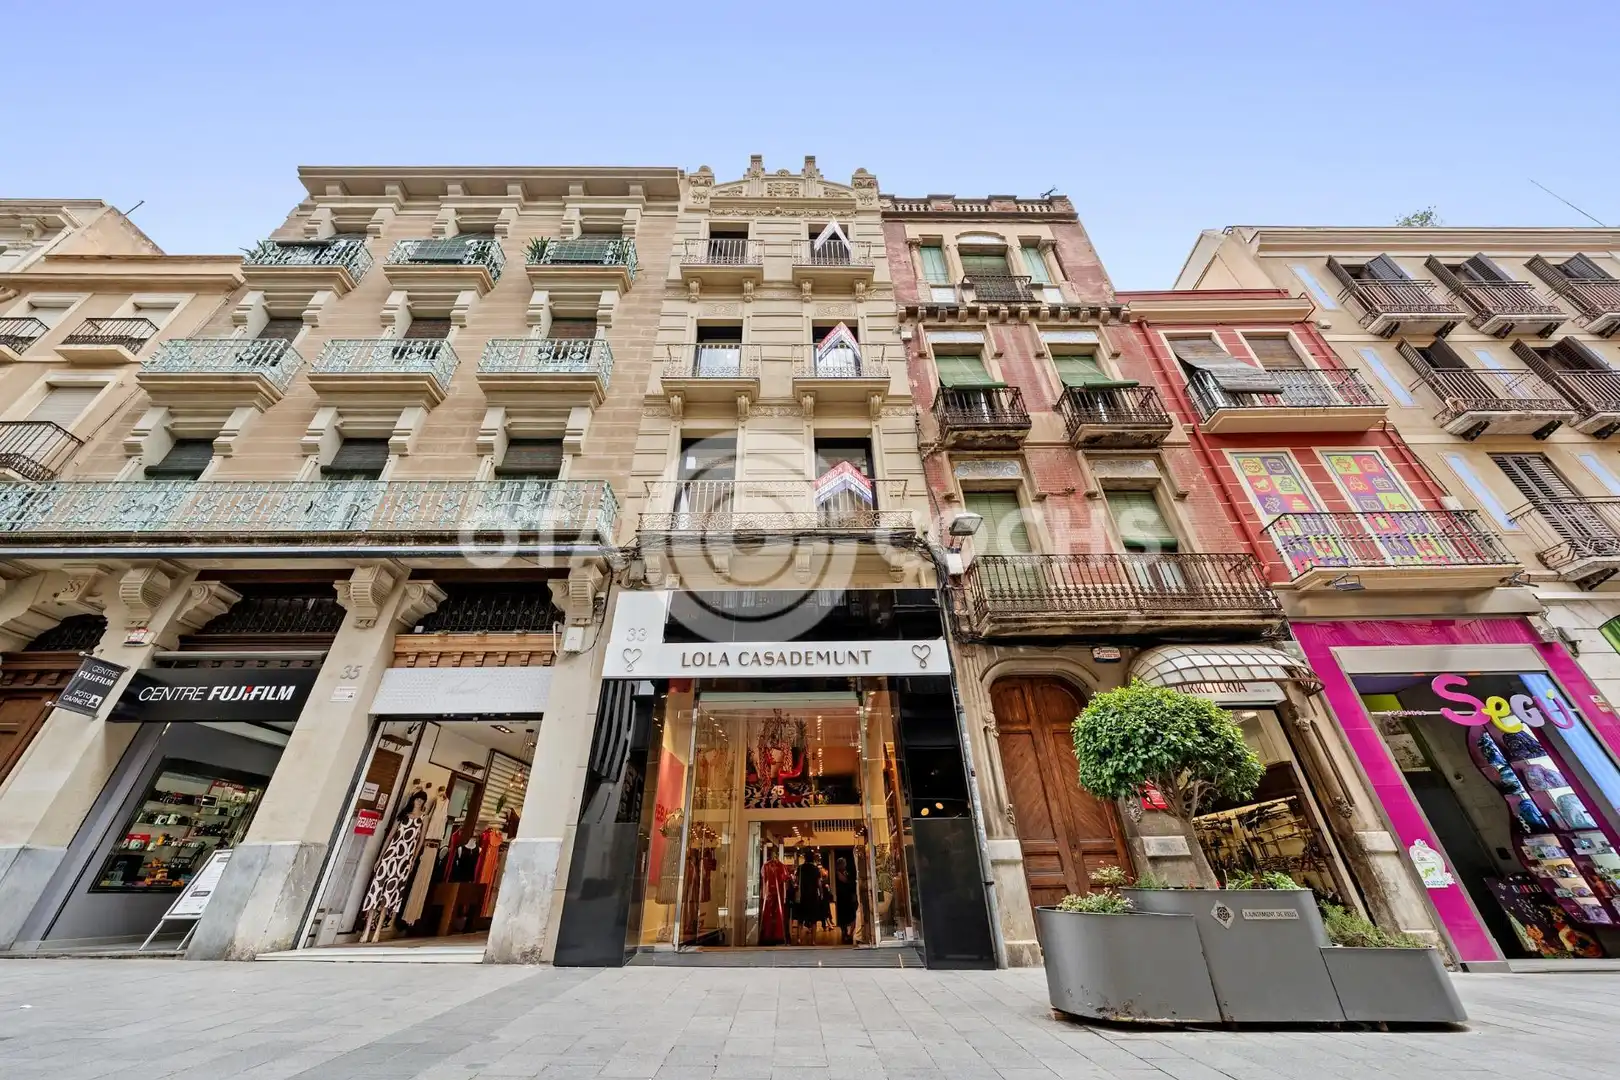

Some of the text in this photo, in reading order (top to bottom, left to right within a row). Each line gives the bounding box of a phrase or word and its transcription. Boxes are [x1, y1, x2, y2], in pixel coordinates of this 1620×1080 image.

[627, 627, 648, 642] 33
[681, 649, 872, 668] LOLA CASADEMUNT
[92, 665, 119, 678] CENTRE
[340, 664, 363, 680] 35
[63, 695, 88, 706] CARNET
[74, 690, 91, 699] FOTO
[138, 686, 208, 702] CENTRE
